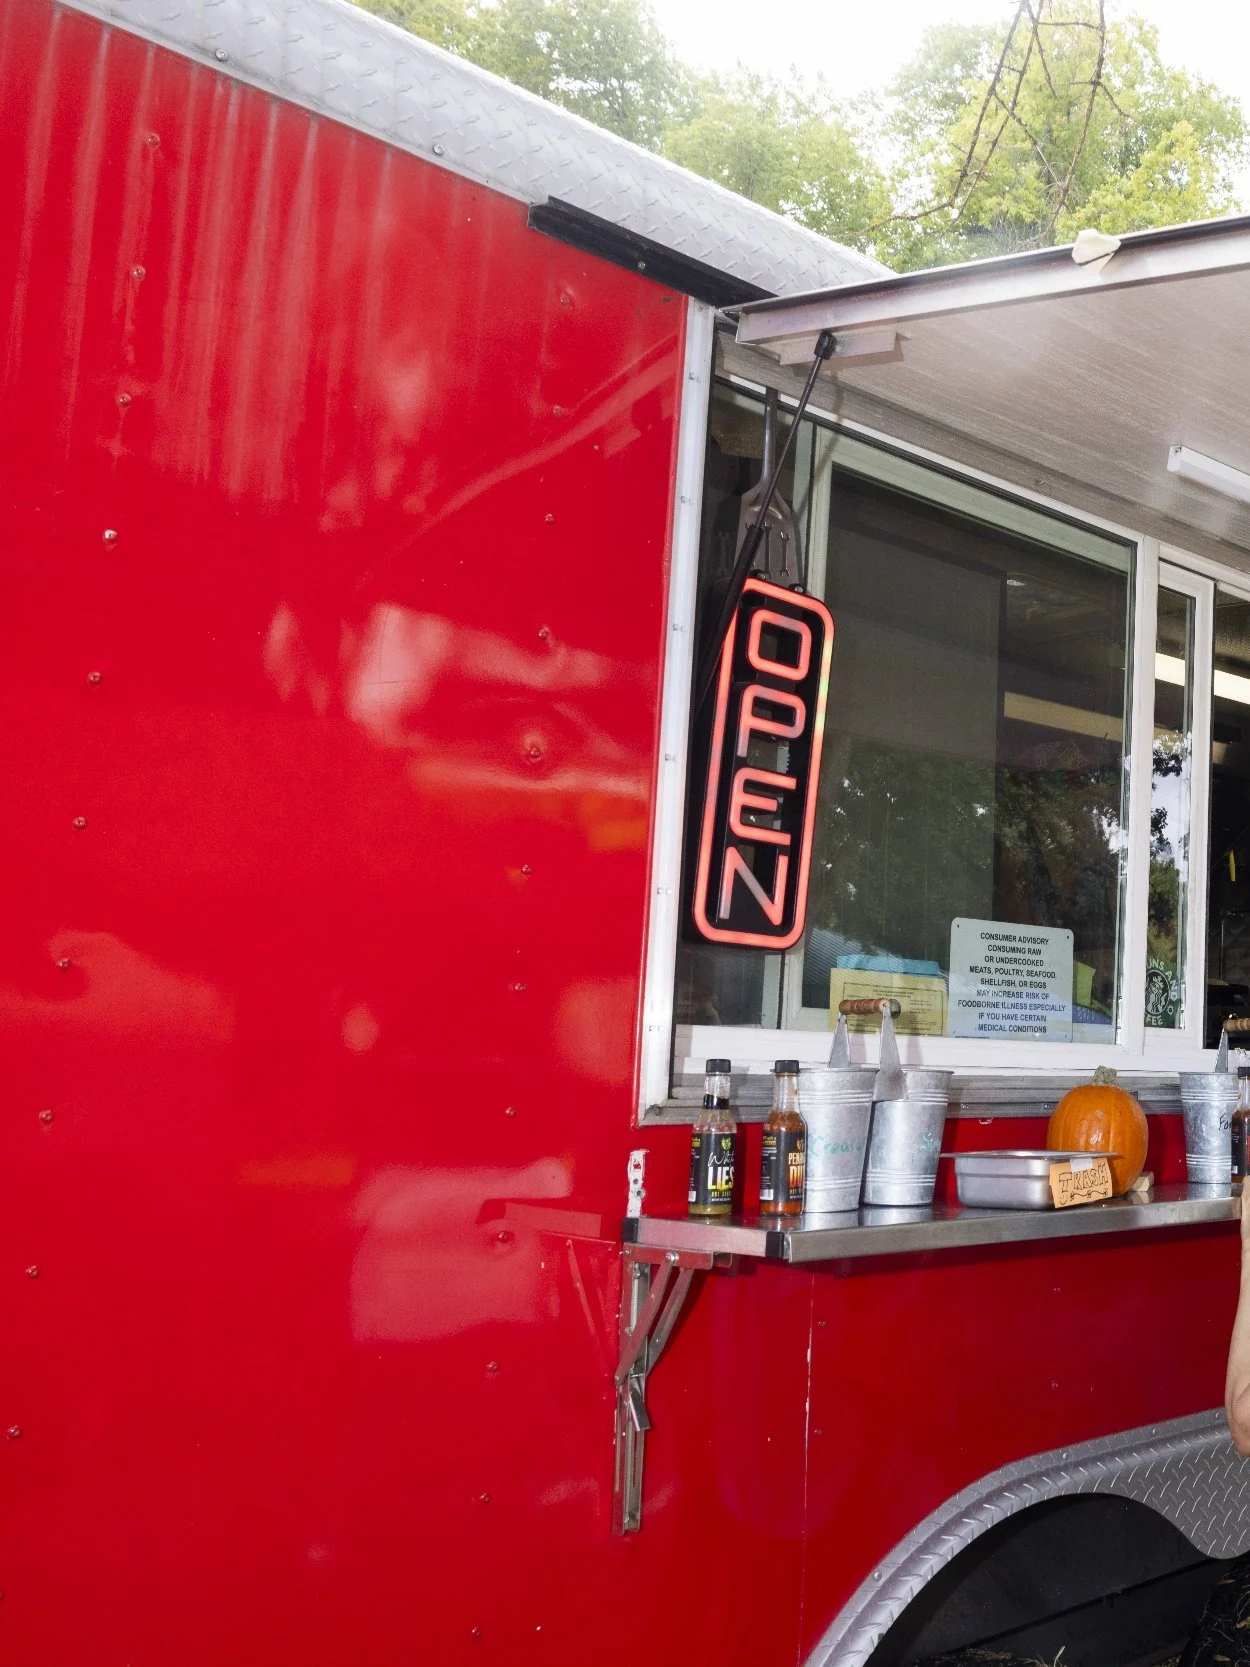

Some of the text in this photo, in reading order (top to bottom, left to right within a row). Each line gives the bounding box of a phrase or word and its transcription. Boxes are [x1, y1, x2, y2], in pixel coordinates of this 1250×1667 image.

[719, 608, 812, 926] OPEN
[980, 932, 1049, 946] CONSUMER ADVISORY
[988, 944, 1042, 956] CONSUMING RAW
[996, 956, 1044, 966] UNDERCOOKED
[970, 966, 993, 975] MEATS,
[994, 968, 1025, 978] POULTRY,
[980, 978, 1046, 989] SHELLFISH, OR EGGS
[992, 990, 1024, 999] INCREASE
[1026, 992, 1039, 1000] RISK
[958, 1000, 1066, 1012] FOODBORNE ILLNESS ESPECIALLY
[978, 1012, 985, 1020] IF
[1002, 1013, 1018, 1021] HAVE
[1020, 1014, 1046, 1022] CERTAIN
[978, 1024, 1046, 1033] MEDICAL CONDITIONS
[708, 1166, 734, 1190] LIES
[1059, 1162, 1108, 1193] TRASH
